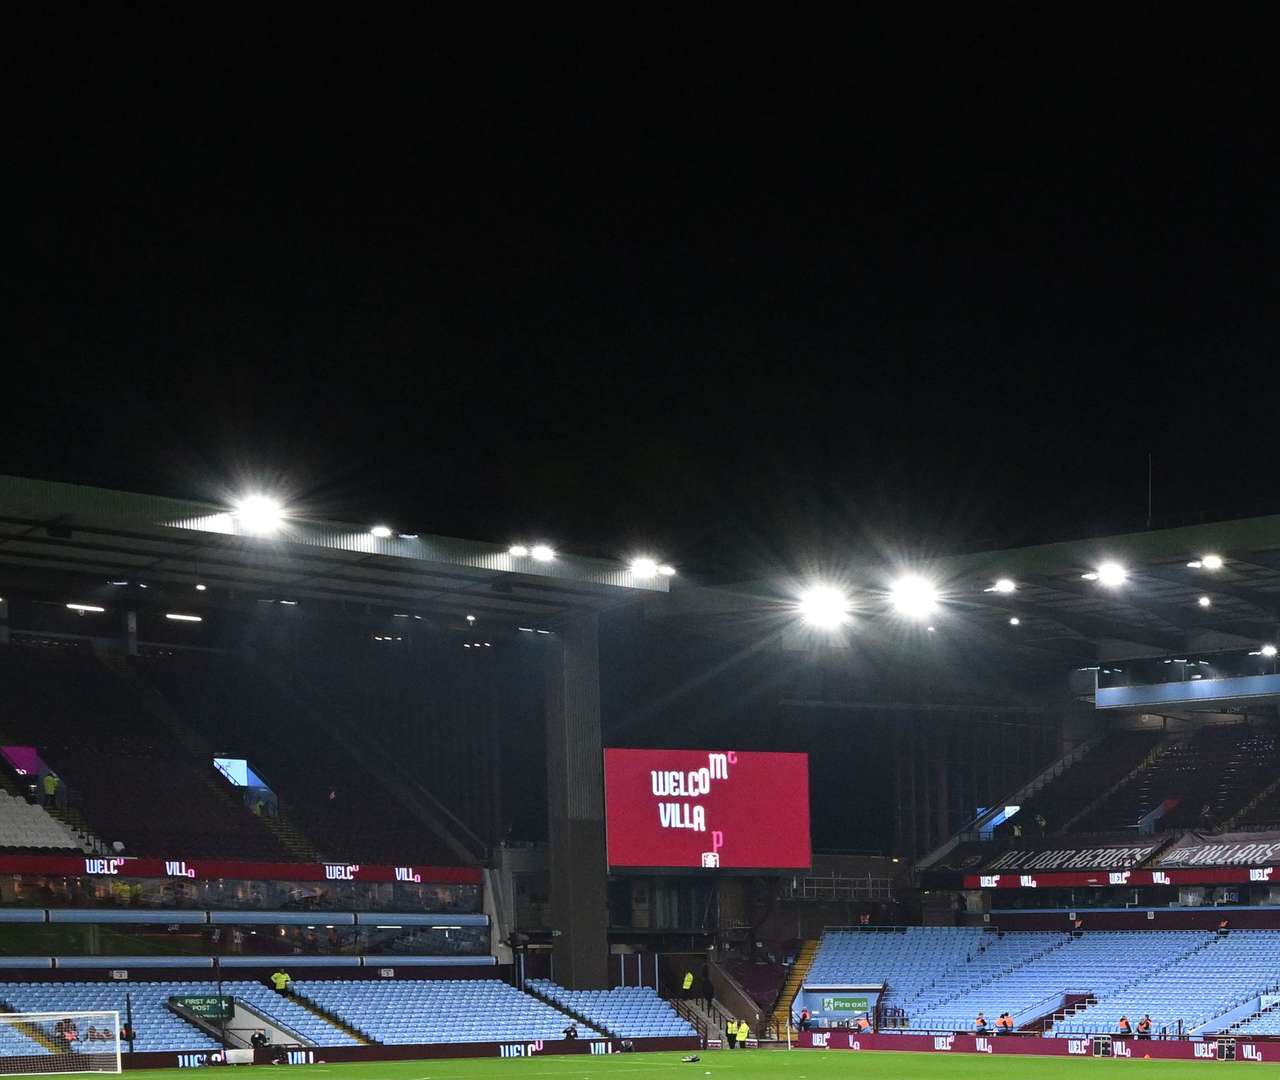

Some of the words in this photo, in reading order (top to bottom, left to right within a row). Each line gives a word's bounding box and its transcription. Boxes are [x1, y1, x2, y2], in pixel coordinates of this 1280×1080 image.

[658, 803, 706, 832] VILLA
[834, 1000, 851, 1008] Fire
[852, 1000, 868, 1008] exit
